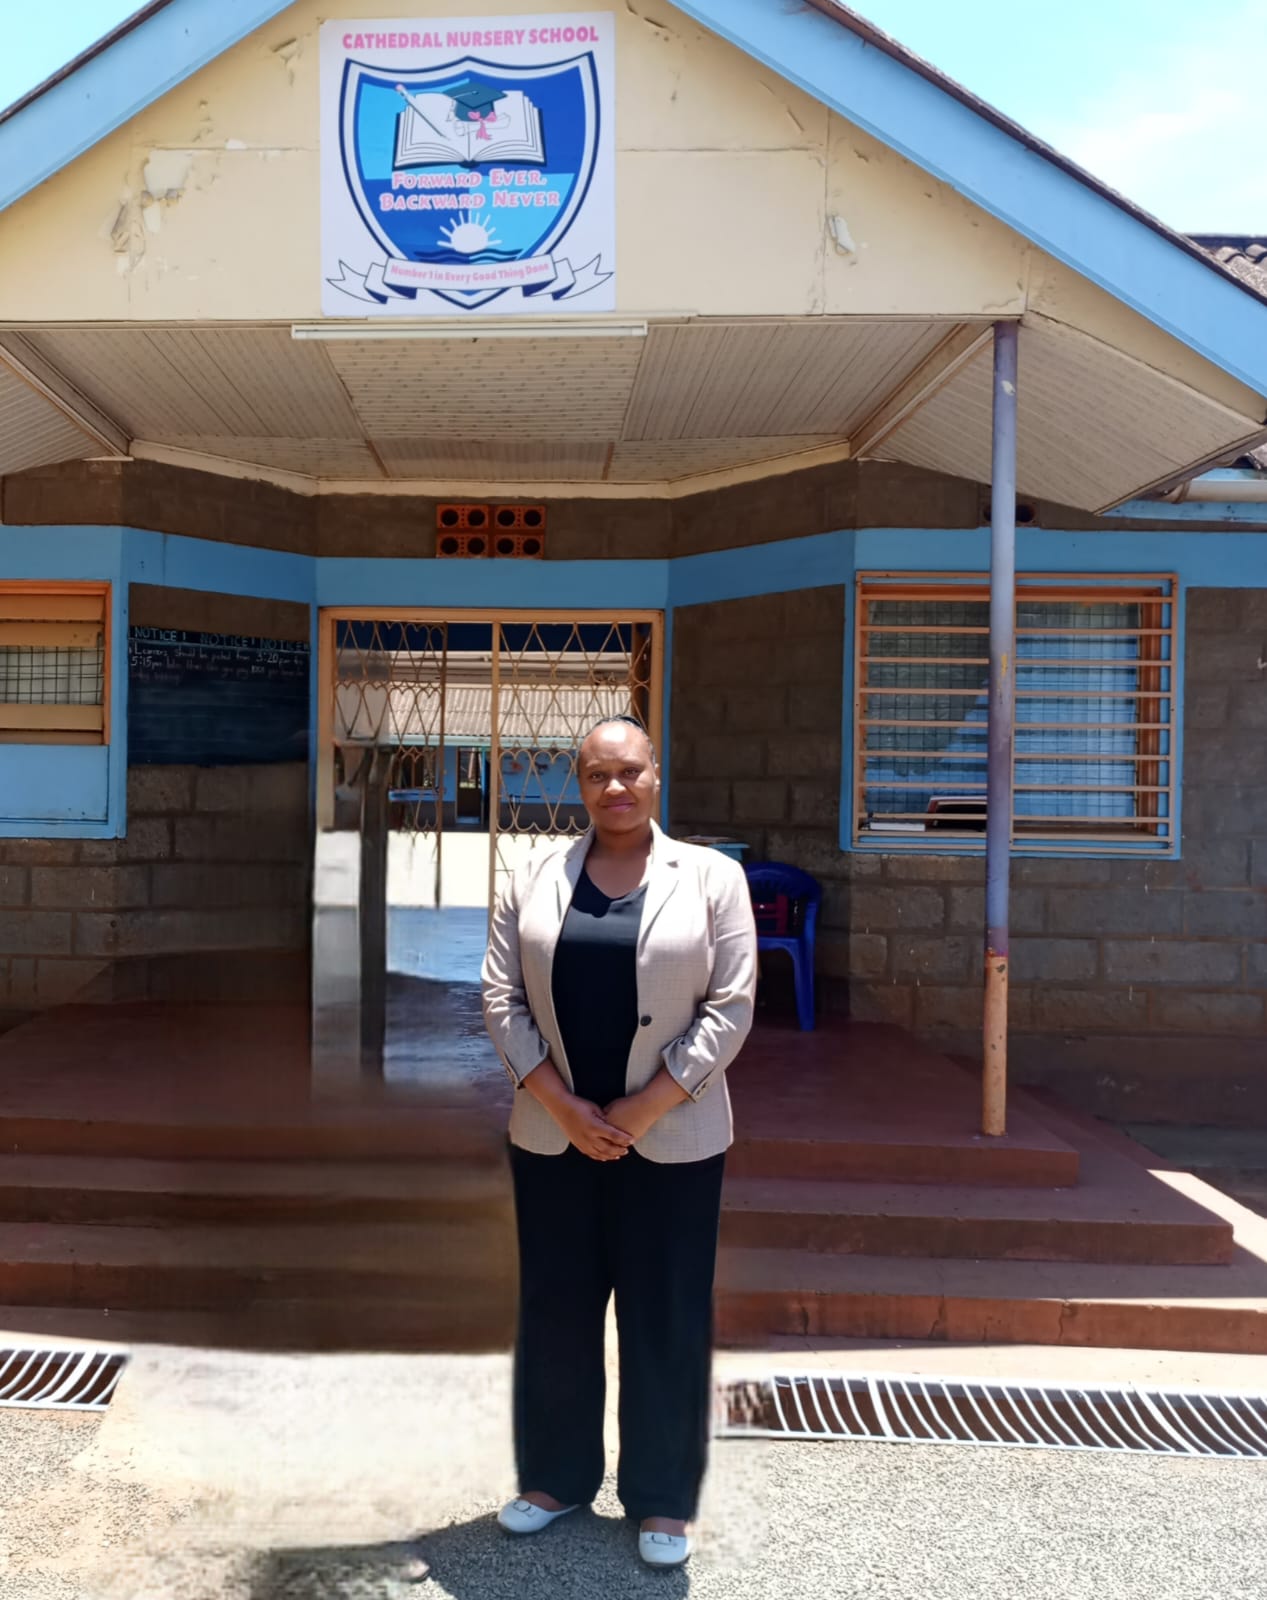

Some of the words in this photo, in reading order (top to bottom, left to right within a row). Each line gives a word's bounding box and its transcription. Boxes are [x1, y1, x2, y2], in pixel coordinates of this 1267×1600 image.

[343, 32, 443, 49] CATHEDRAL
[446, 29, 525, 47] NURSERY
[528, 26, 599, 45] SCHOOL
[390, 265, 427, 279] Number
[434, 270, 443, 280] in
[445, 271, 471, 284] Every
[472, 271, 497, 281] Good
[498, 266, 525, 279] Thing
[526, 263, 549, 275] Done
